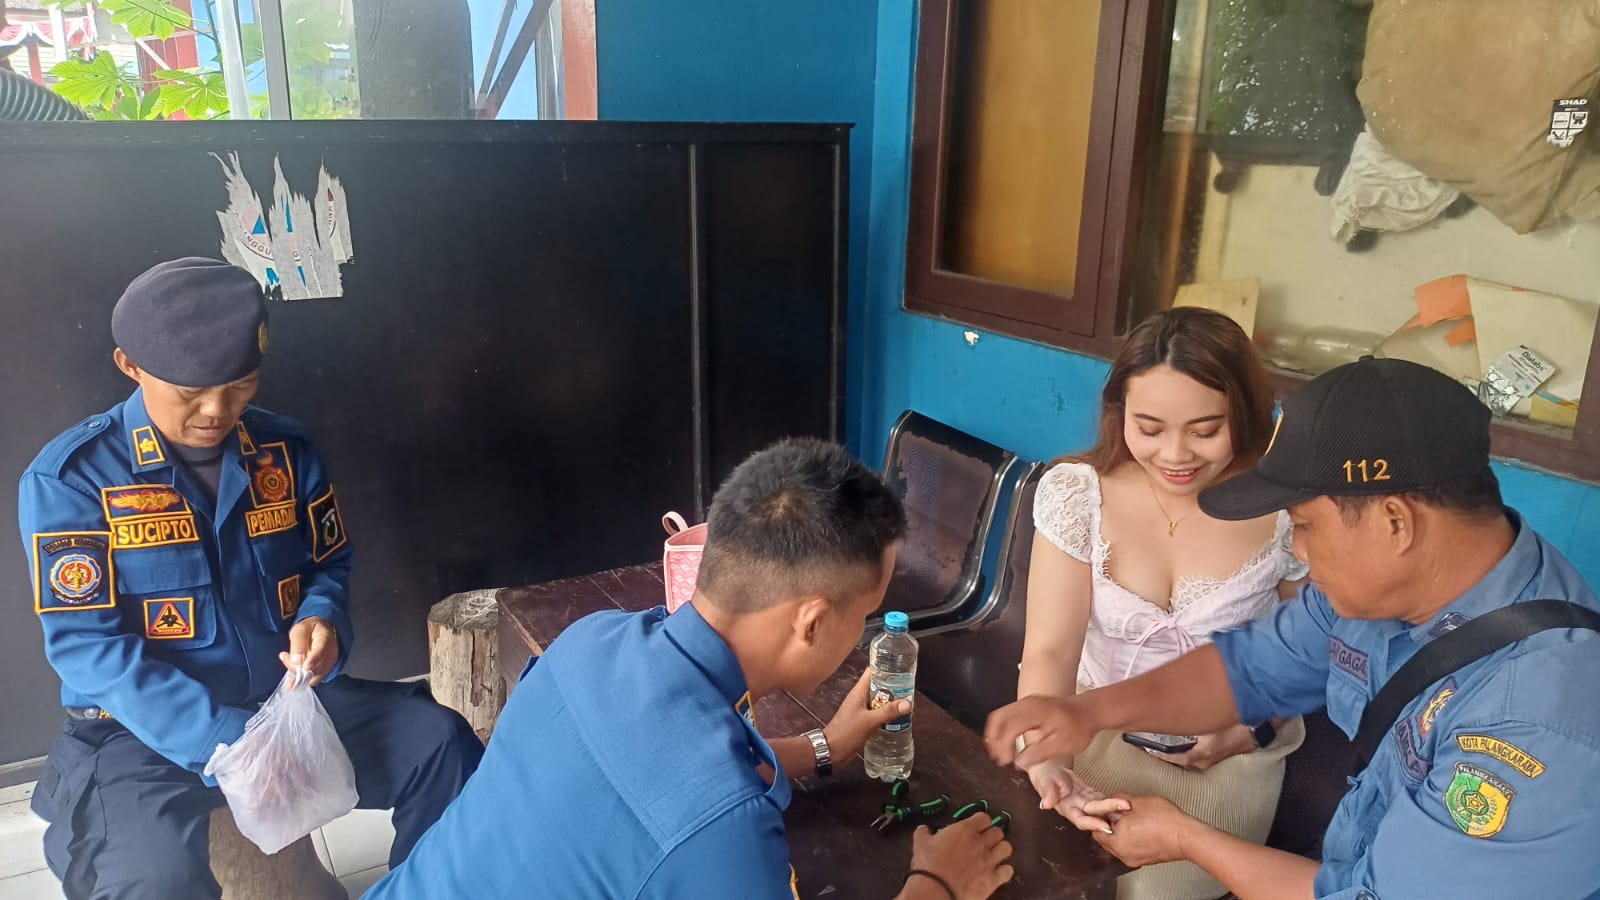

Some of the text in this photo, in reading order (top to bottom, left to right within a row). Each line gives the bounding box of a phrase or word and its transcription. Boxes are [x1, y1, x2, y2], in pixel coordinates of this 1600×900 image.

[1343, 460, 1391, 483] 112
[118, 519, 191, 545] SUCIPTO
[1461, 738, 1479, 750] KOTA
